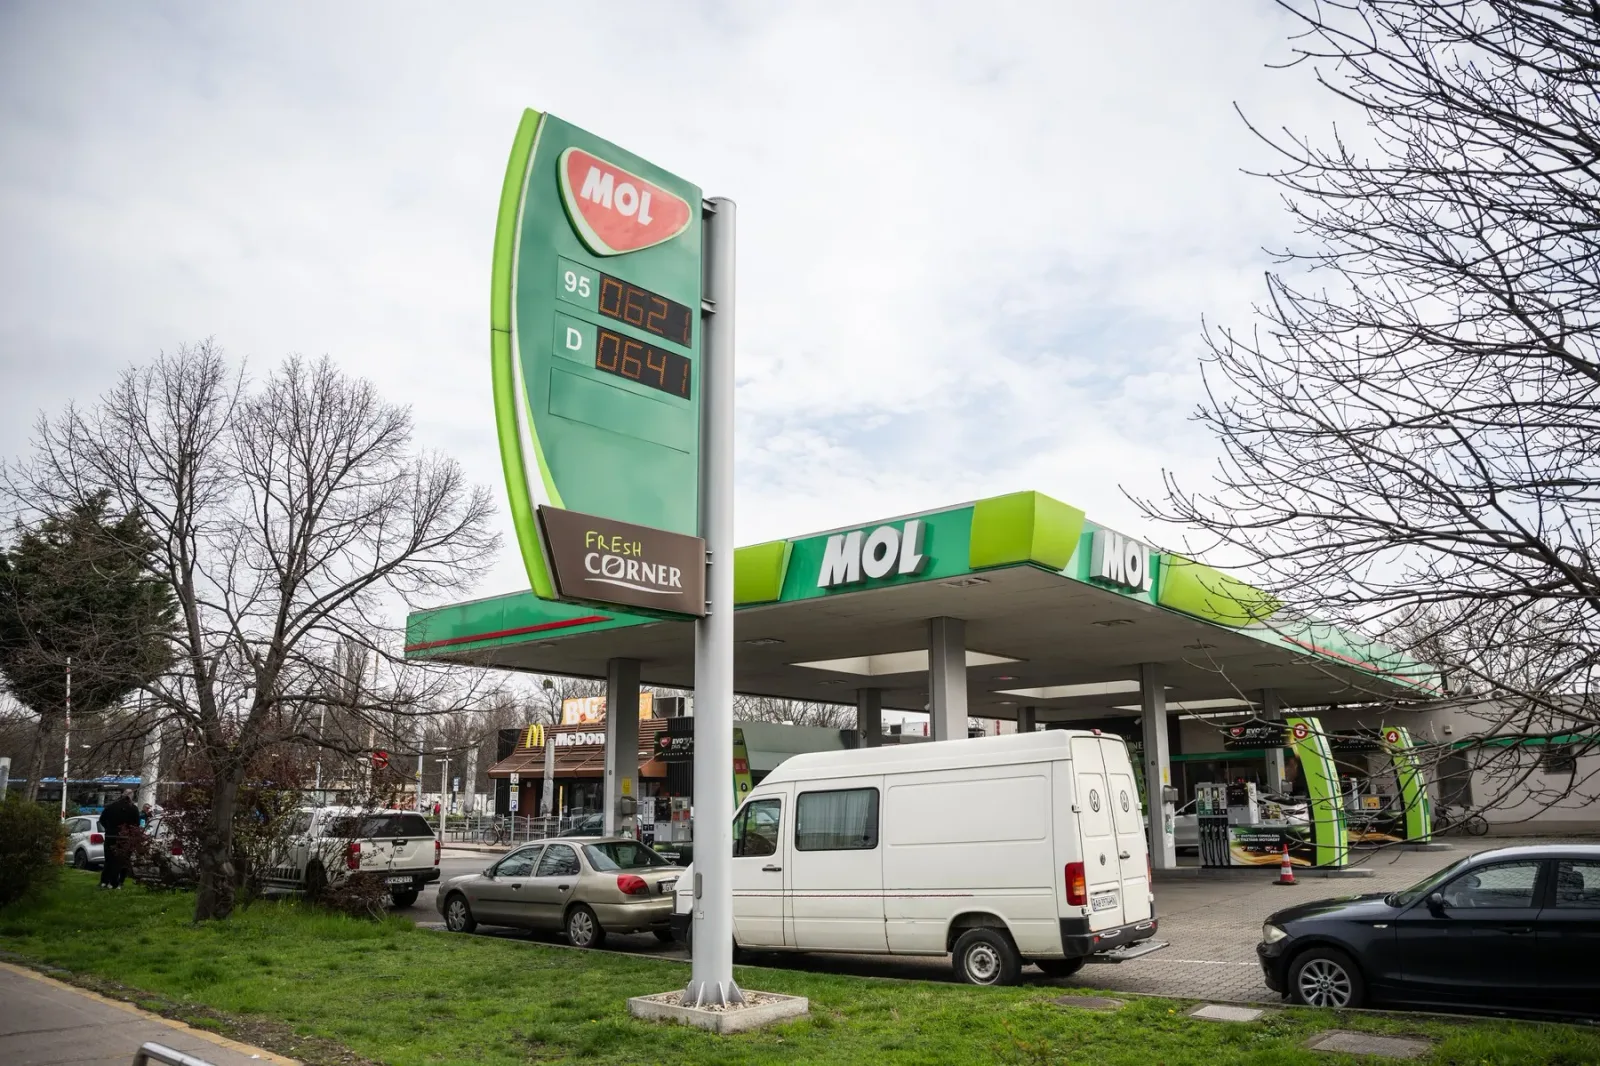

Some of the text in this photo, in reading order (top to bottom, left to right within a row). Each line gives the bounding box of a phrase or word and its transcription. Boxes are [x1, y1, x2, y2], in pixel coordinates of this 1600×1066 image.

[580, 165, 653, 226] MOL
[564, 270, 591, 298] 95
[565, 327, 583, 351] D
[585, 530, 643, 557] FRESH
[817, 519, 929, 588] MOL
[584, 552, 682, 588] CORNER
[1100, 528, 1154, 592] MOL
[555, 732, 606, 746] McDon
[1388, 732, 1397, 742] 4
